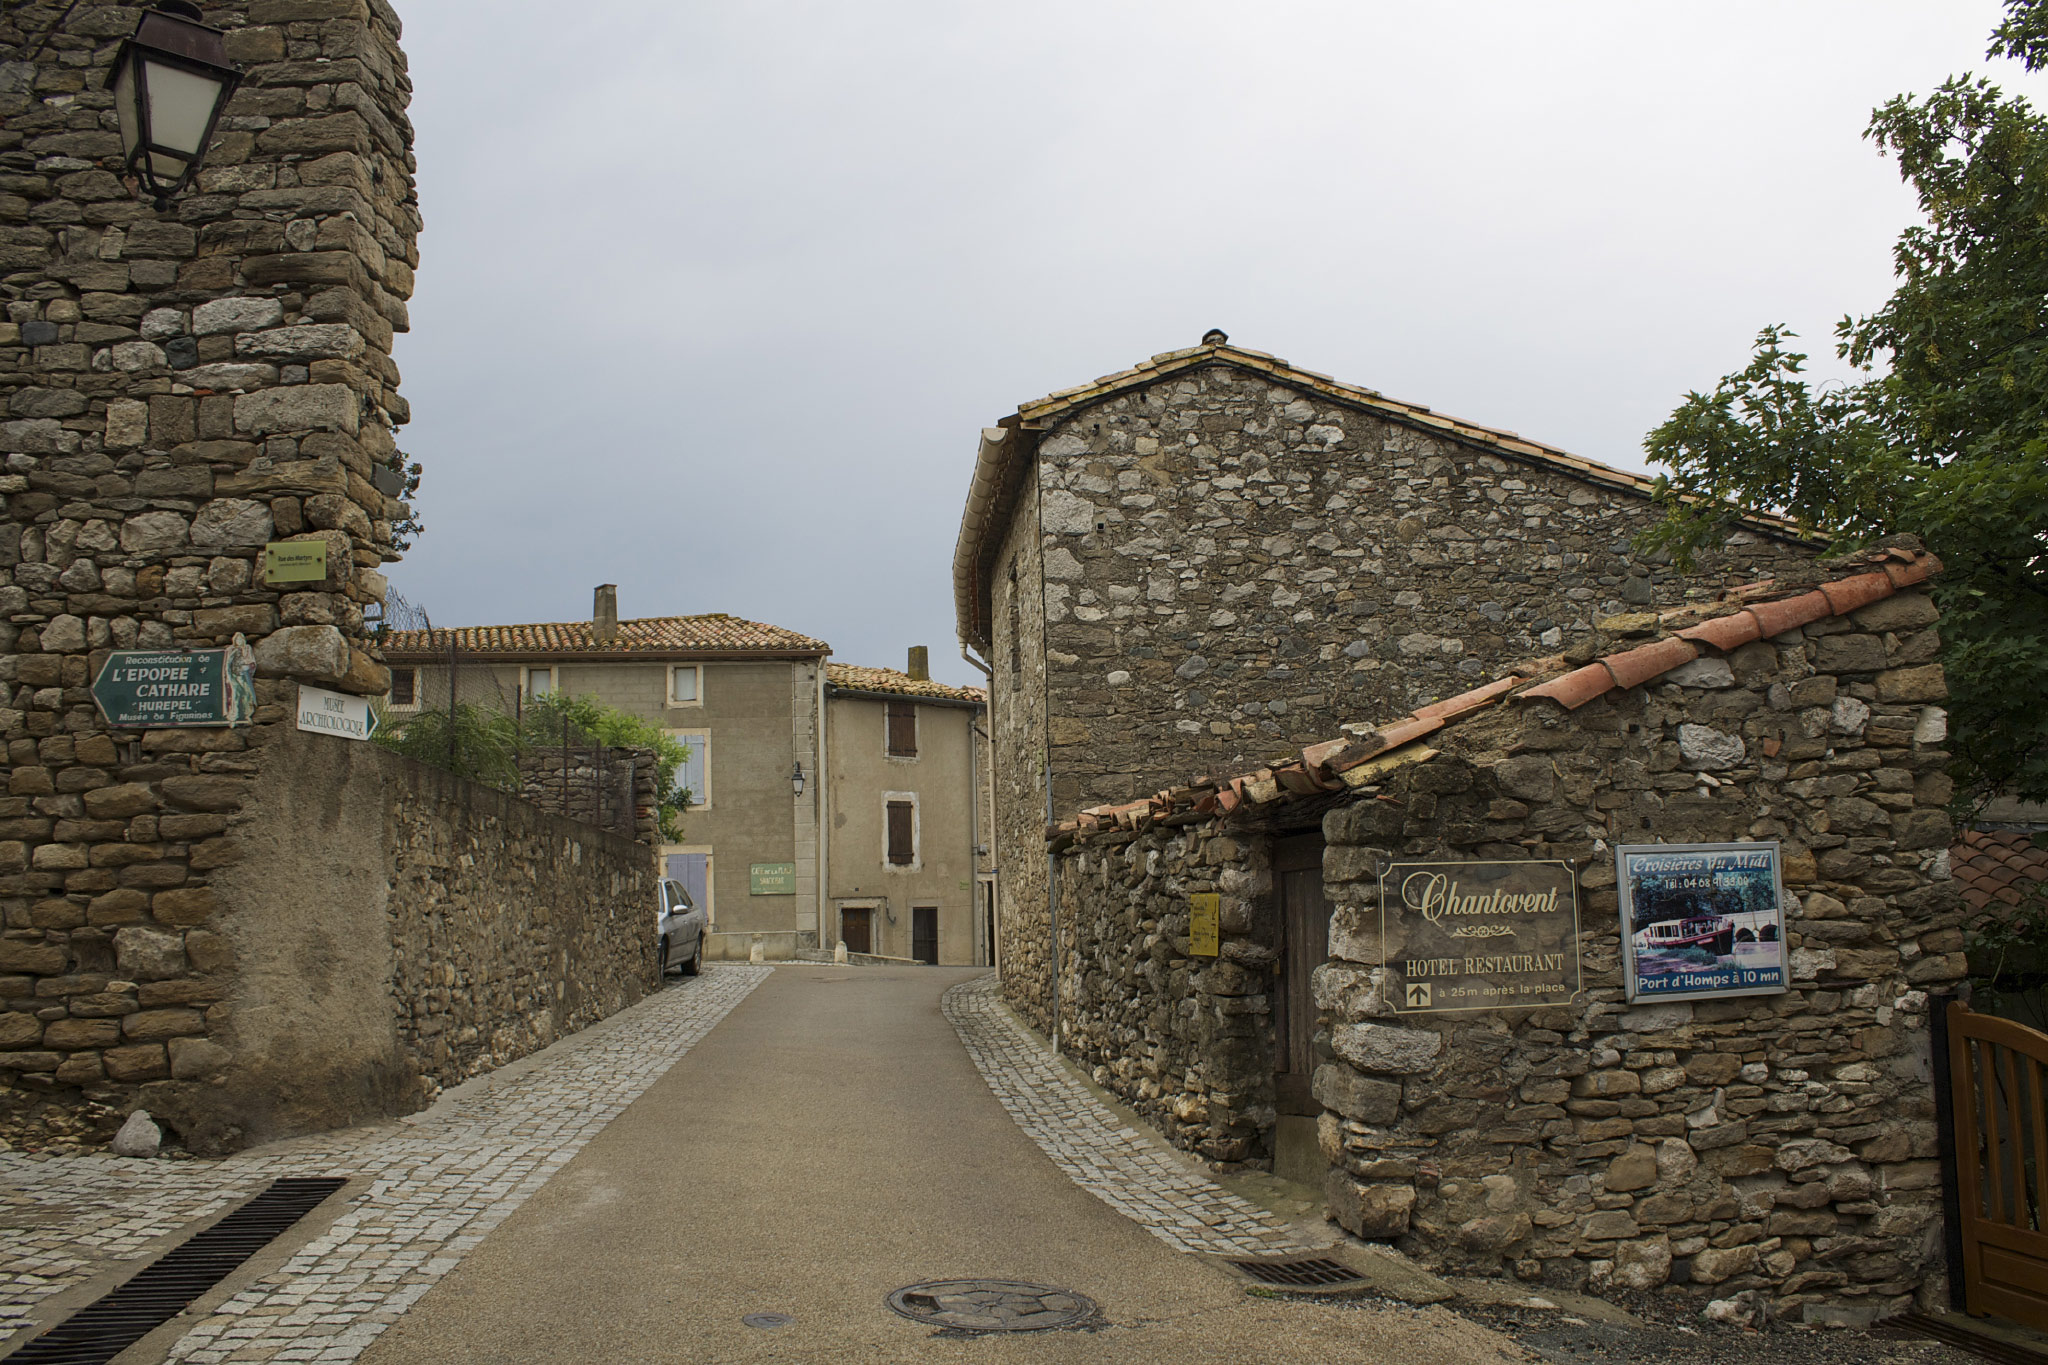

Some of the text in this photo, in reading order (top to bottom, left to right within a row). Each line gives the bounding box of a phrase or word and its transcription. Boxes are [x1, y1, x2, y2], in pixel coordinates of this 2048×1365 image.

[125, 654, 210, 665] Reconstitution de
[112, 667, 189, 682] L'EPOPEE
[136, 683, 210, 697] CATHARE
[118, 711, 213, 722] Musée de Figurines
[1632, 854, 1769, 872] Croisières du Midi
[1402, 871, 1559, 928] Chantovent
[1406, 953, 1564, 977] HOTEL RESTAURANT
[1639, 970, 1779, 989] Port d'Homps à 10 mn
[1439, 988, 1446, 998] à
[1483, 985, 1515, 997] après
[1520, 984, 1530, 994] la
[1534, 983, 1565, 996] place
